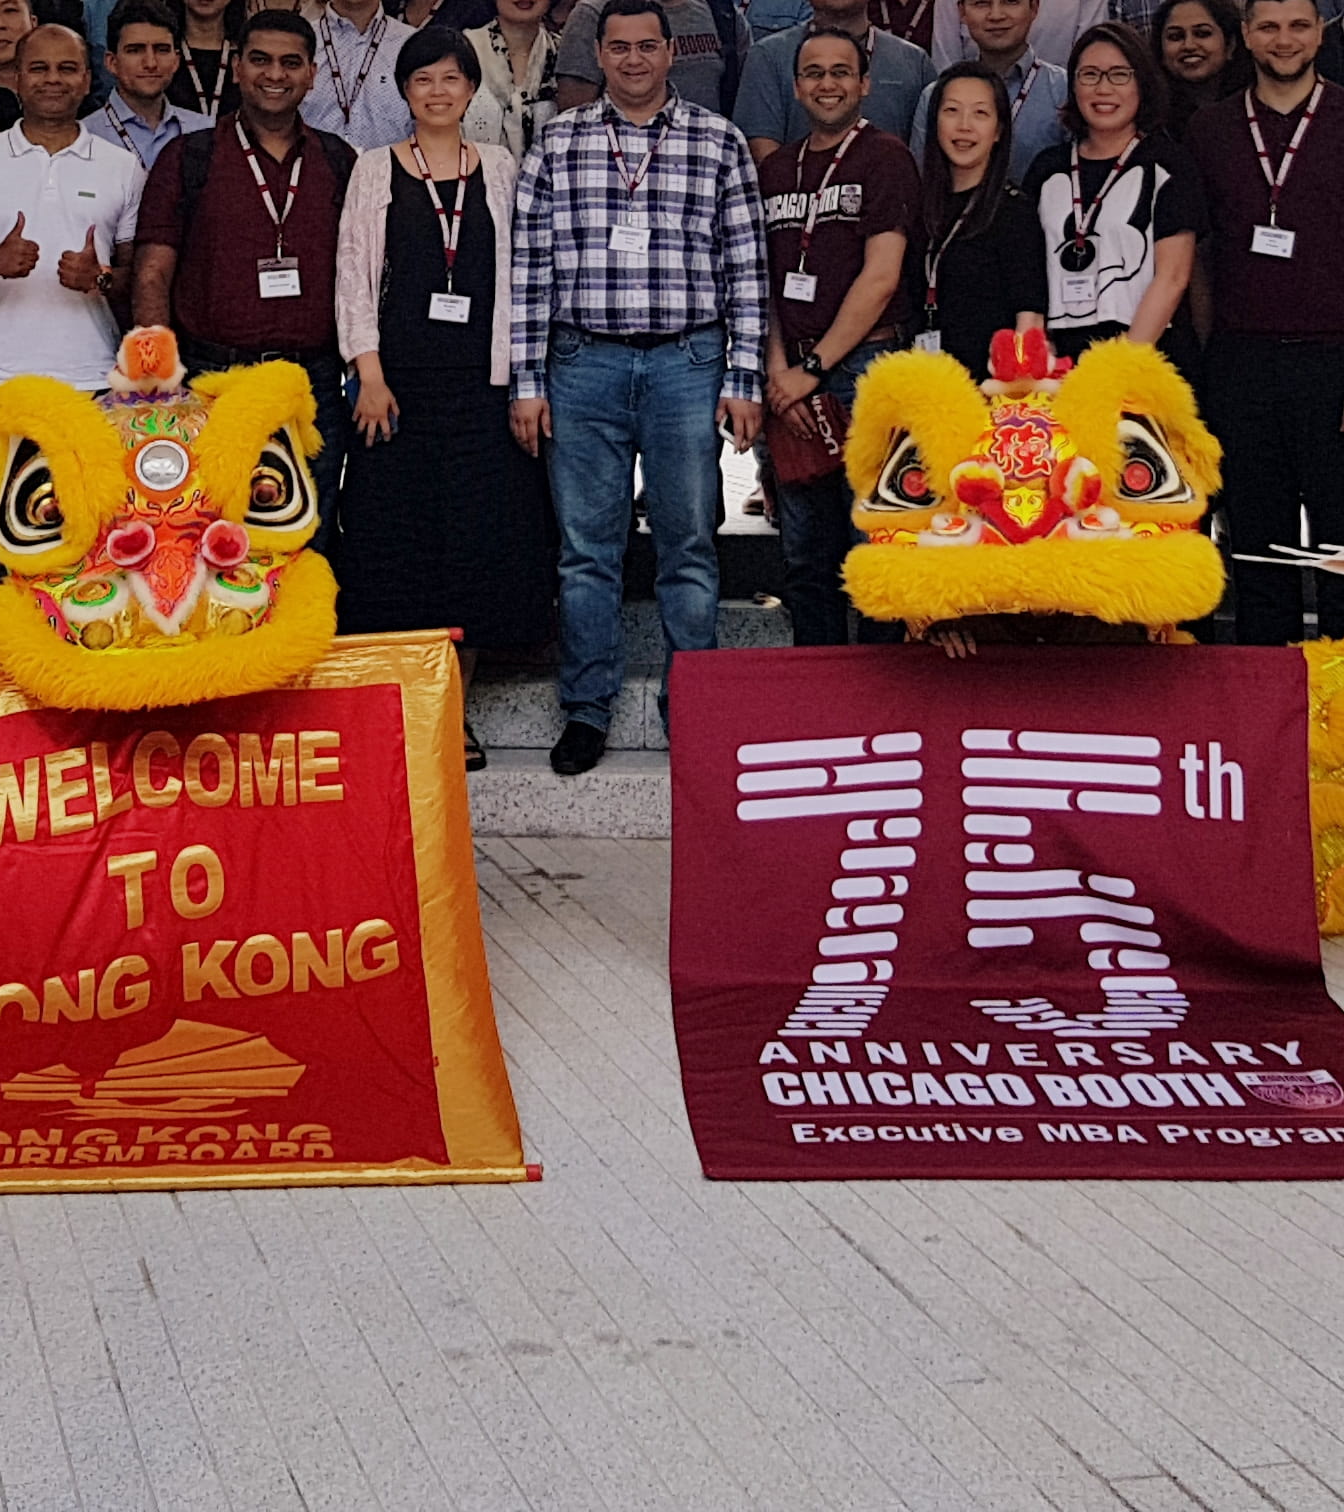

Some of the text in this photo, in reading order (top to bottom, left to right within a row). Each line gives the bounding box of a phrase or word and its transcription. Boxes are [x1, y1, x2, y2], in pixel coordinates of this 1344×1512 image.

[107, 844, 225, 930] TO
[181, 918, 400, 1002] KONG
[759, 1040, 1304, 1067] ANNIVERSARY
[762, 1071, 1246, 1108] CHICAGO BOOTH
[136, 1122, 333, 1144] KONG
[791, 1122, 1025, 1144] Executive
[1038, 1123, 1148, 1144] MBA
[157, 1142, 336, 1162] BOARD
